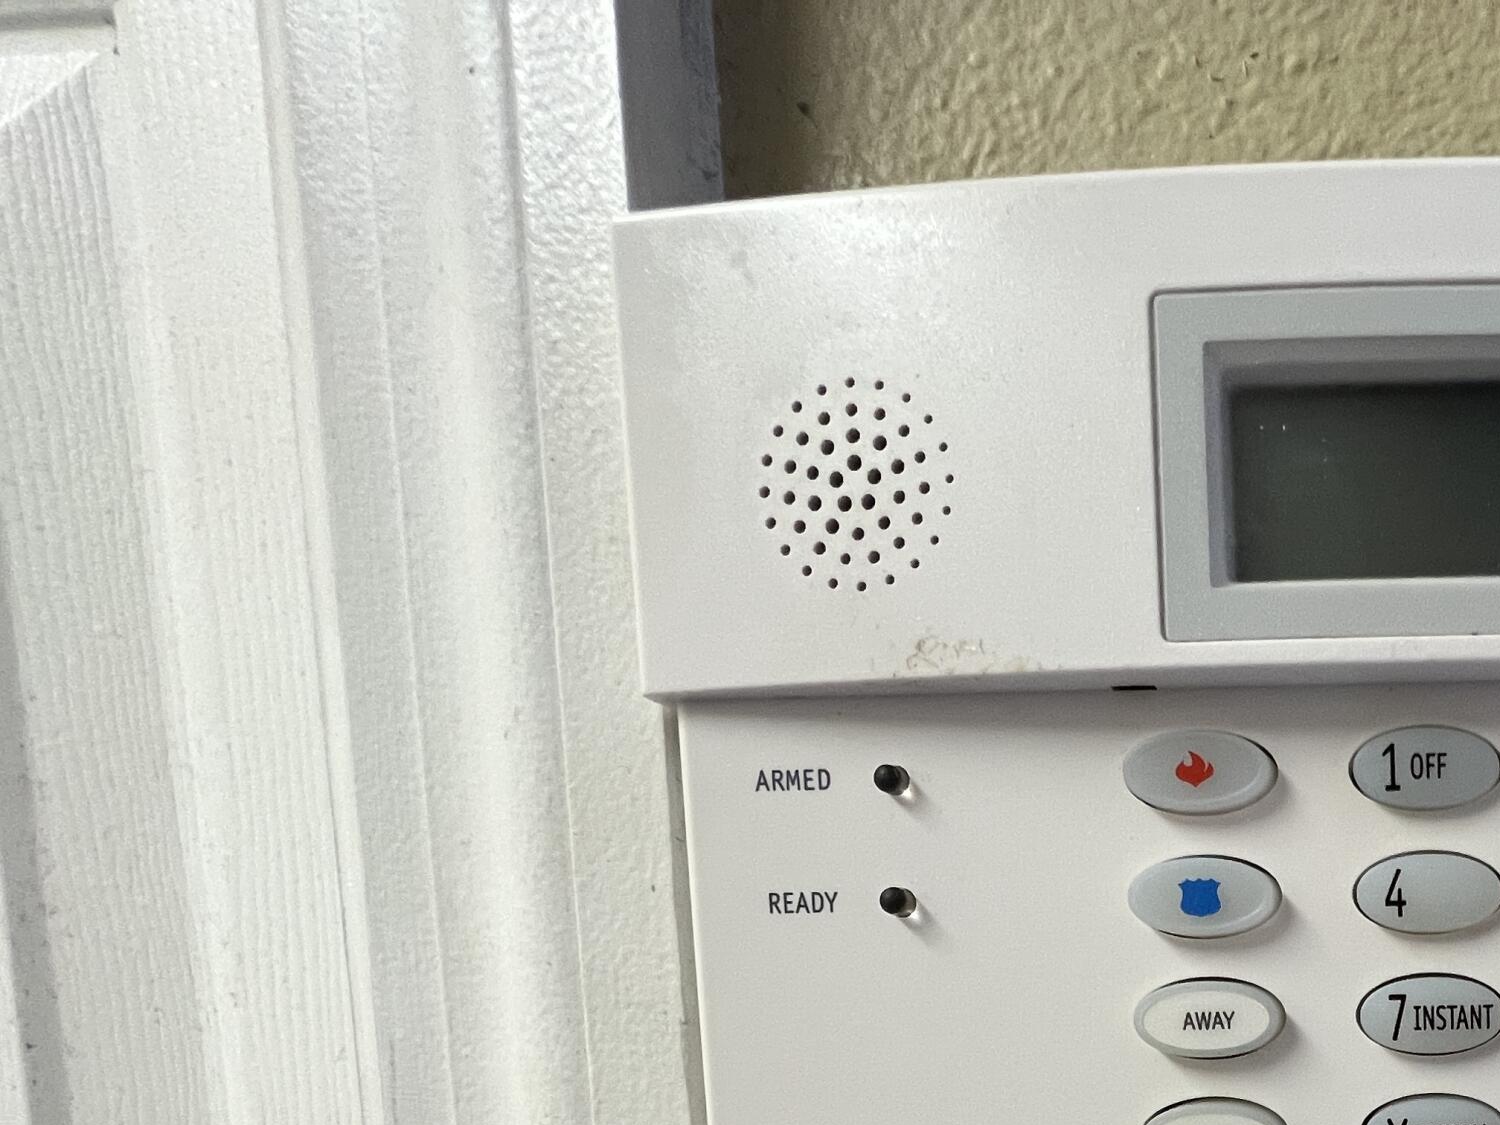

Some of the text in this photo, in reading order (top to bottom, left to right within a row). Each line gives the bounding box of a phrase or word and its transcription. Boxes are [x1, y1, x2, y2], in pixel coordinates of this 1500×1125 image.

[755, 768, 831, 792] ARMED
[1383, 743, 1448, 791] 1 OFF
[768, 891, 838, 914] READY
[1383, 868, 1406, 917] 4
[1182, 1010, 1235, 1030] AWAY
[1387, 994, 1493, 1041] 7 INSTANT
